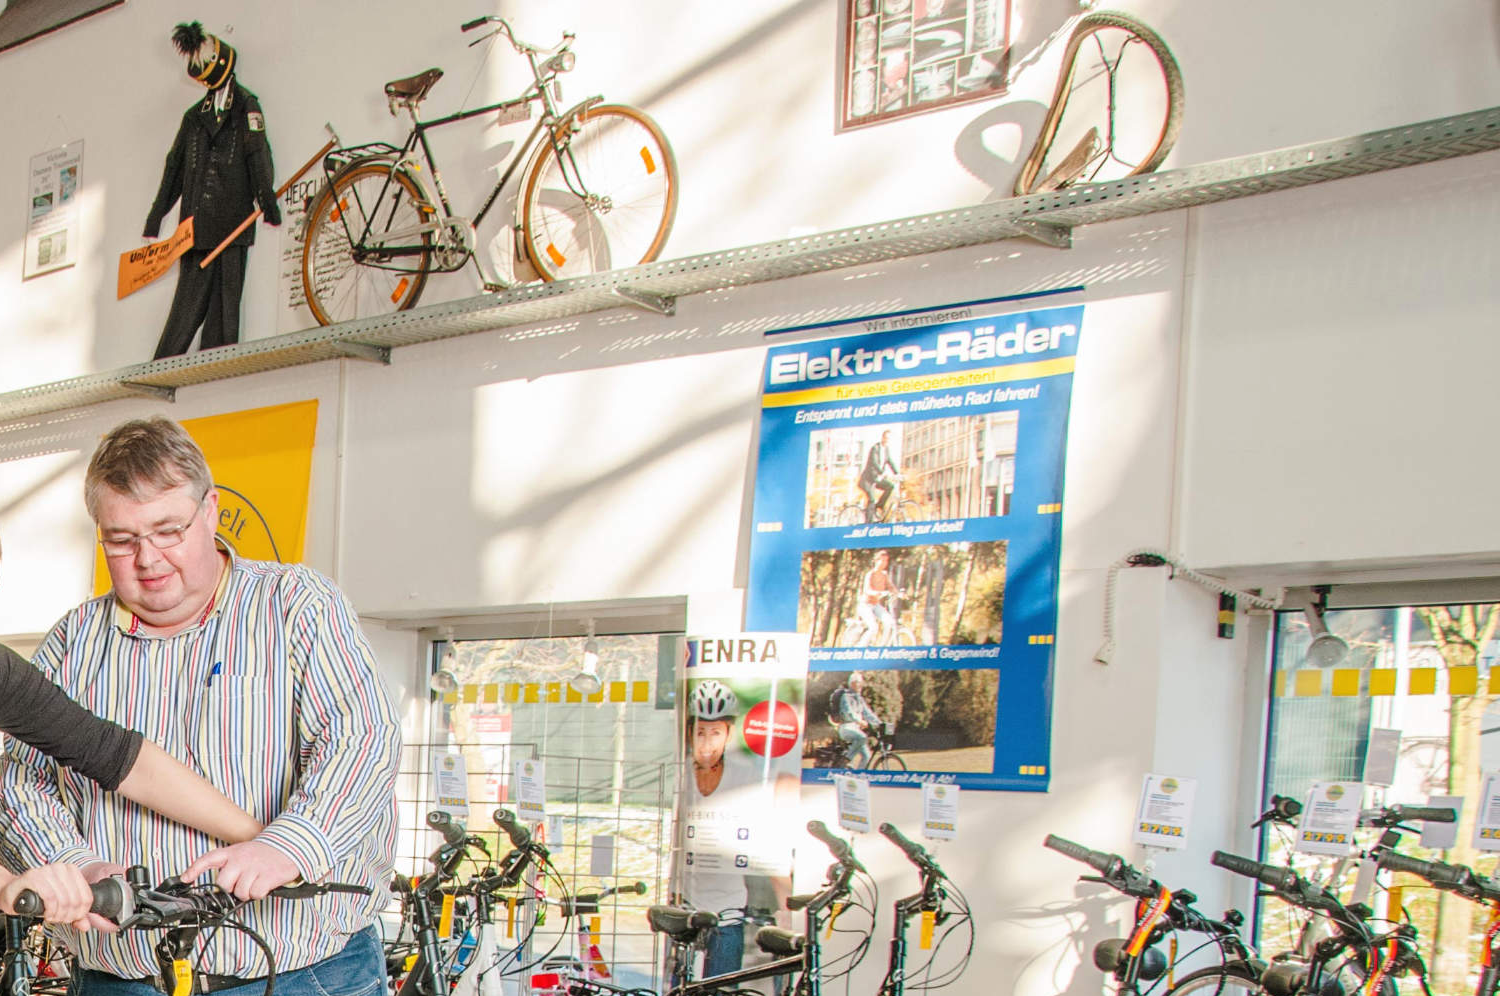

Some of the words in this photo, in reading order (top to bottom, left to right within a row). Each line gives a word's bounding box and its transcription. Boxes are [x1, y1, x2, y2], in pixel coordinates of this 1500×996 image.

[864, 318, 886, 331] Wir
[891, 308, 972, 328] informieren!
[770, 322, 1076, 385] Elektro-Räder
[836, 386, 853, 399] für
[858, 383, 887, 397] viele
[891, 371, 995, 393] Gelegenheiten!
[794, 405, 852, 424] Entspannt
[853, 402, 878, 418] und
[879, 400, 907, 414] stets
[909, 393, 962, 412] mühelos
[964, 389, 992, 405] Rad
[993, 384, 1040, 402] fahren!
[869, 526, 891, 537] dem
[892, 524, 913, 537] Weg
[914, 523, 930, 534] zur
[931, 520, 964, 533] Arbeit!
[700, 639, 780, 663] ENRA
[833, 648, 862, 660] radeln
[863, 648, 879, 659] bei
[880, 648, 928, 661] Anstiegen
[939, 647, 1000, 661] Gegenwind!
